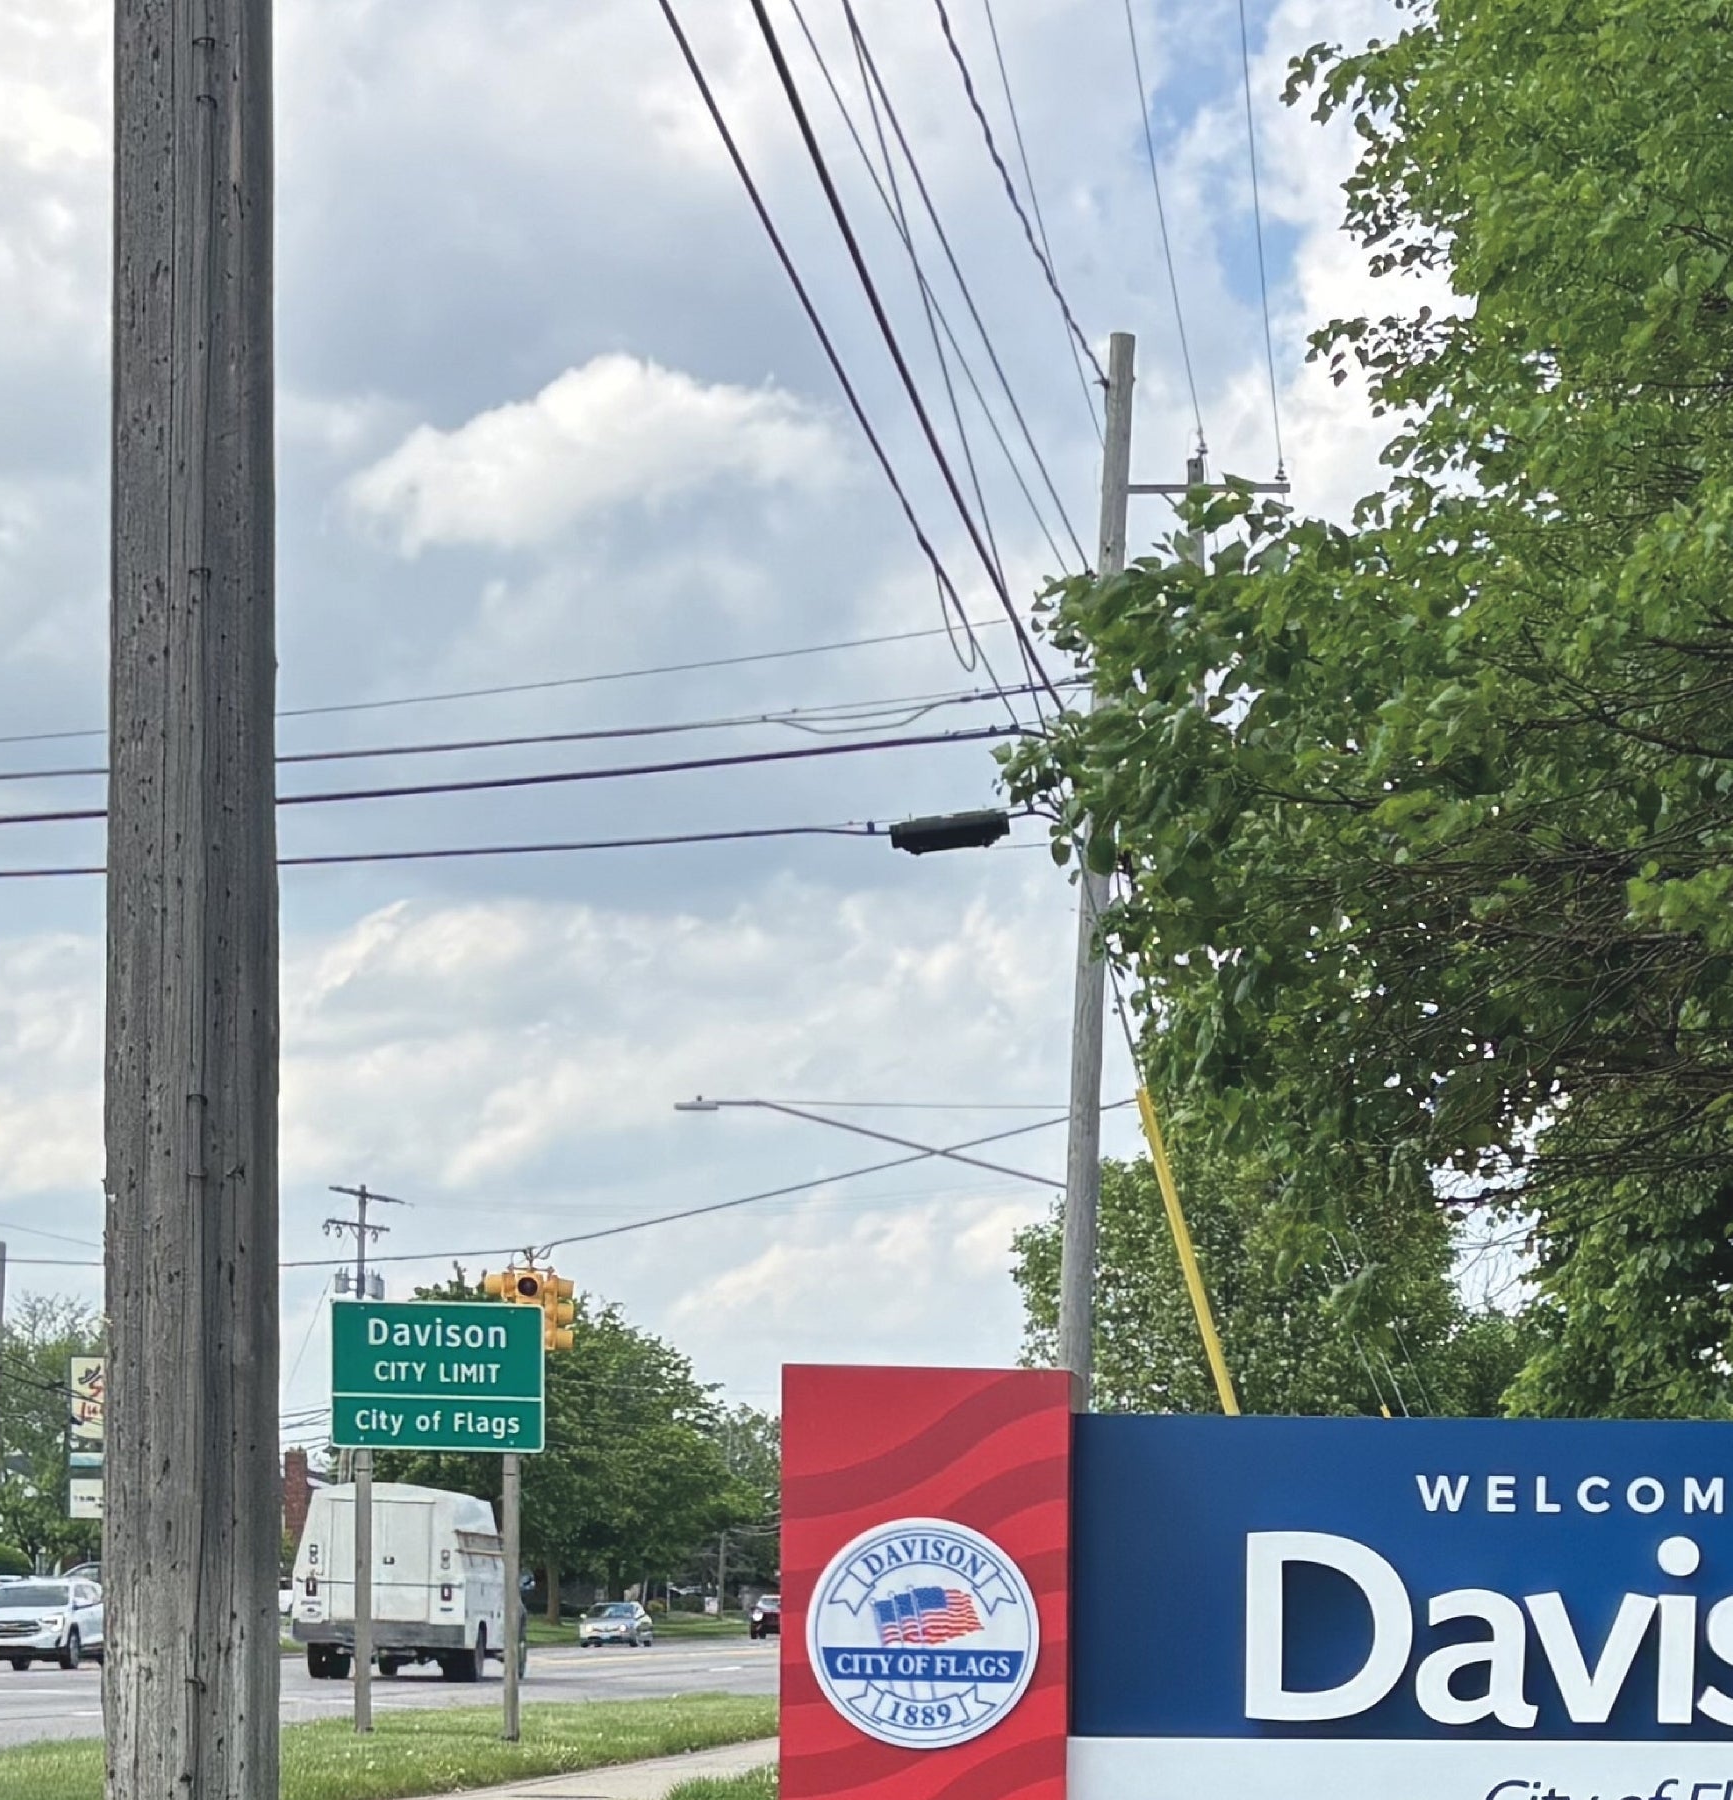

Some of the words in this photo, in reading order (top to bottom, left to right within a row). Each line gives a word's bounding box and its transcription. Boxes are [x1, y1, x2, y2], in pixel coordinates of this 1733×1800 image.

[367, 1317, 507, 1348] Davison
[374, 1361, 426, 1382] CITY
[439, 1363, 501, 1384] LIMIT
[355, 1409, 404, 1437] City
[415, 1410, 442, 1432] of
[453, 1412, 521, 1440] Flags
[861, 1538, 989, 1578] DAVISON
[836, 1653, 894, 1675] CITY
[897, 1654, 931, 1676] OF
[934, 1655, 1011, 1678] FLAGS
[888, 1700, 952, 1727] 1889
